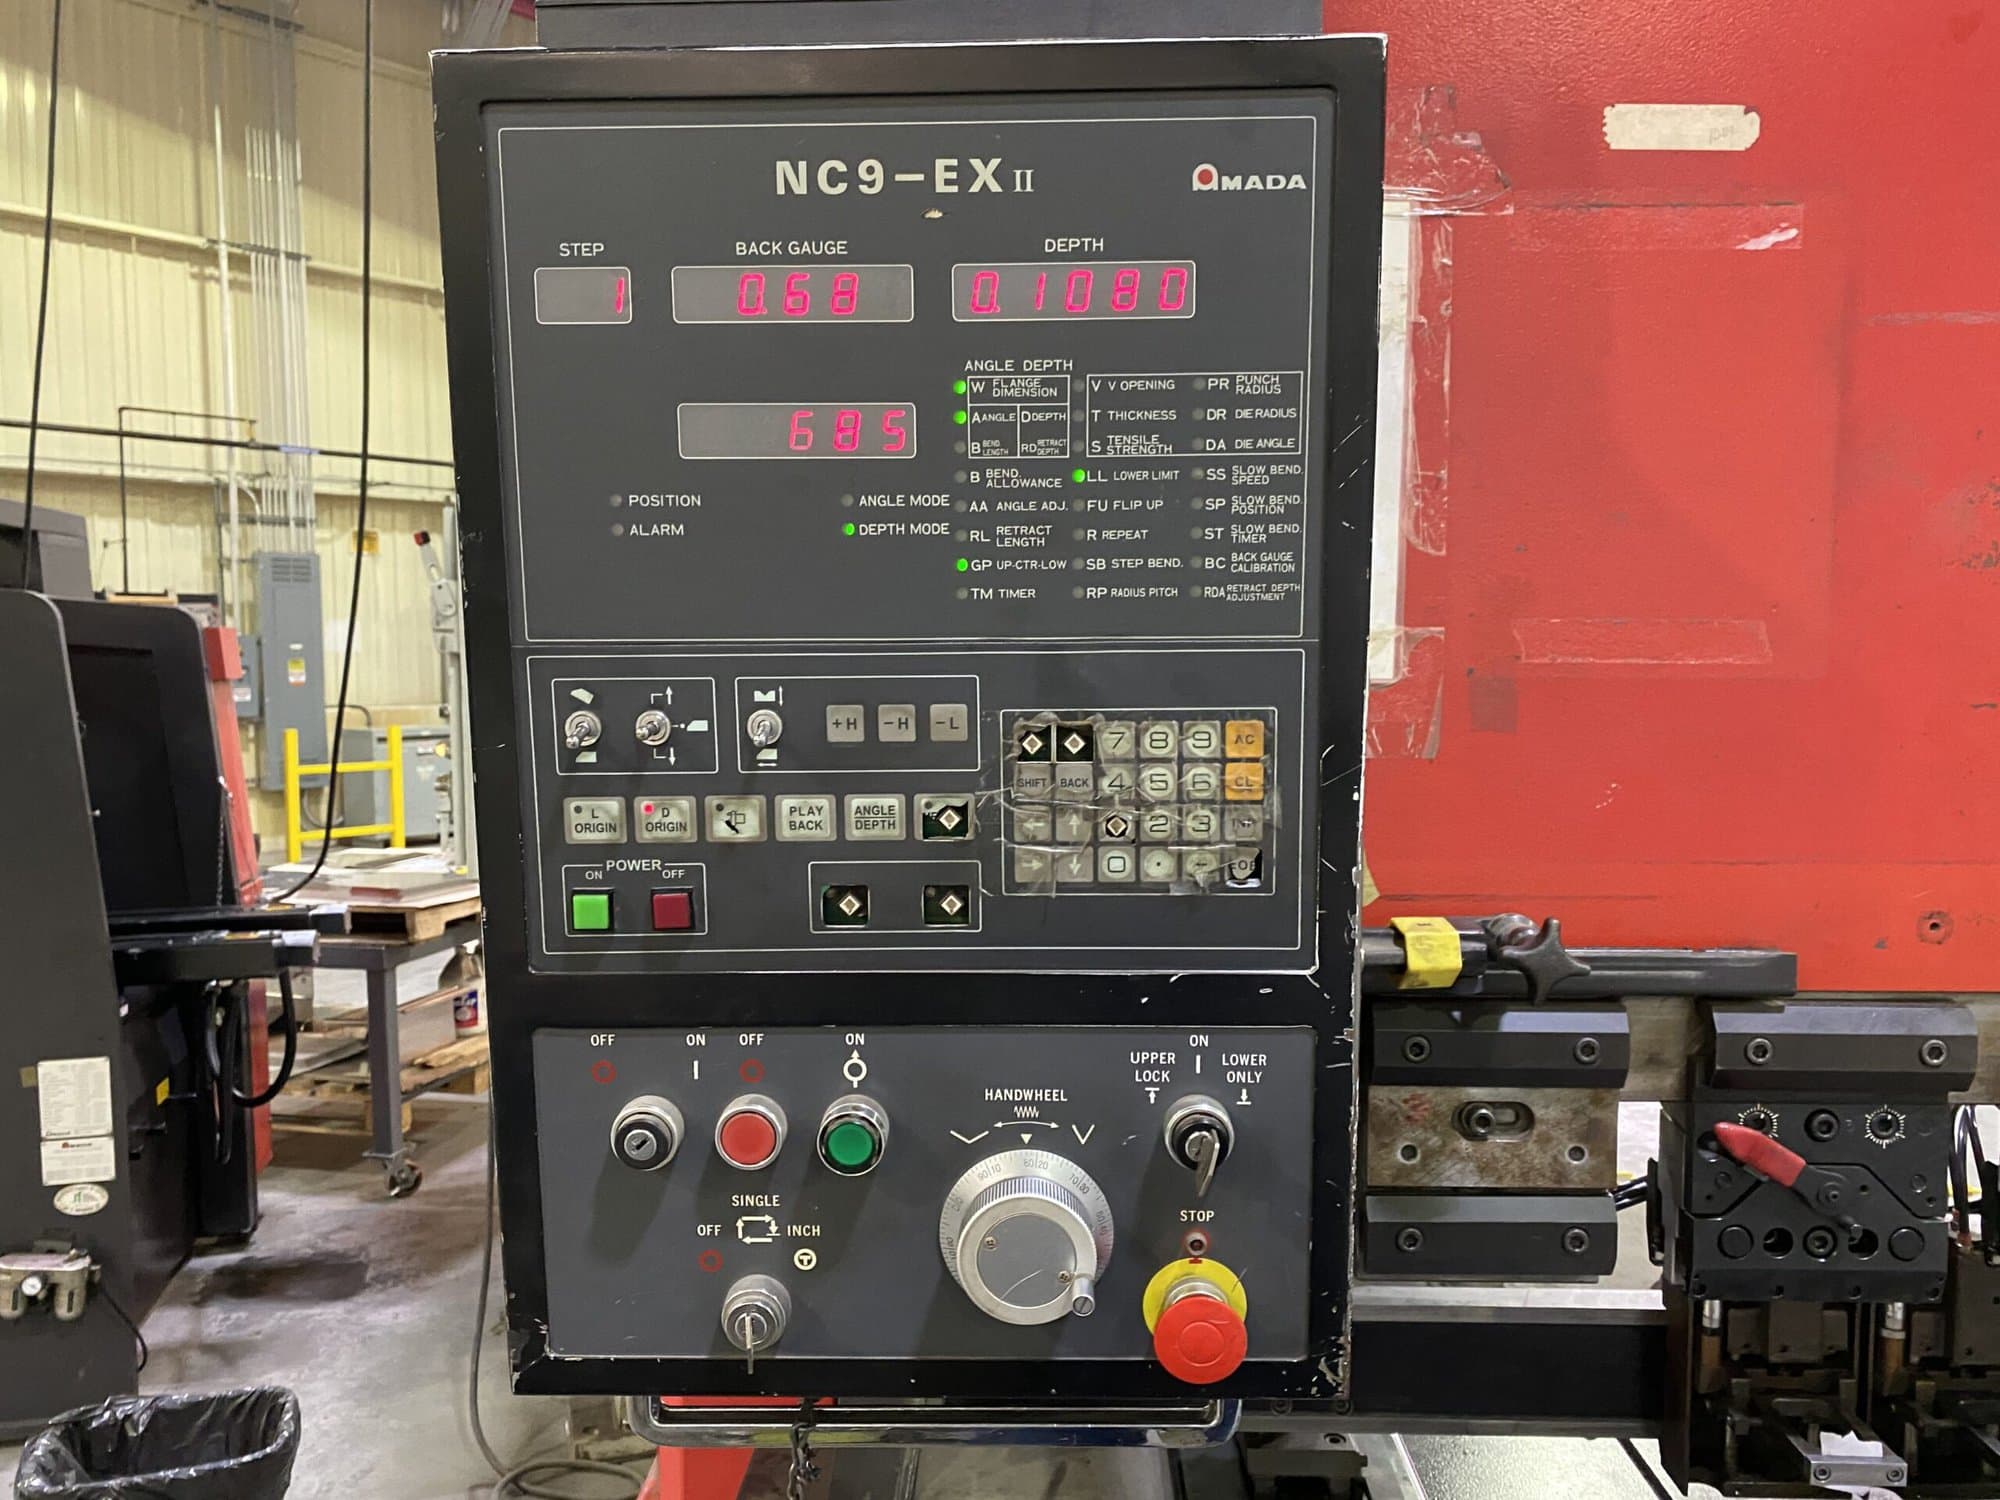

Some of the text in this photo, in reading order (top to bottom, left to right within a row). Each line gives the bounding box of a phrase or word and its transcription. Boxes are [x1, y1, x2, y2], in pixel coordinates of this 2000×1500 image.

[1192, 163, 1307, 192] AMADA
[559, 242, 605, 258] STEP
[735, 240, 849, 256] BACK GAUGE
[1043, 237, 1105, 254] DEPTH
[614, 276, 626, 314] 1
[964, 359, 1074, 372] ANGLE DEPTH
[992, 378, 1042, 388] FLANGE
[1091, 379, 1176, 392] V V OPENING
[1207, 378, 1230, 391] PR
[1235, 374, 1280, 386] PUNCH
[970, 381, 986, 393] W
[992, 387, 1058, 397] DIMENSION
[1235, 384, 1282, 396] RADIUS
[1091, 409, 1177, 422] T THICKNESS
[1206, 408, 1297, 421] DR DIE RADIUS
[982, 439, 1000, 448] BEND
[1037, 438, 1067, 447] RETRACT
[1106, 434, 1160, 446] TENSILE
[1206, 437, 1296, 451] DA DIE ANGLE
[971, 441, 981, 454] B
[982, 448, 1009, 456] LENGTH
[1021, 443, 1038, 453] RD
[1037, 447, 1060, 456] DEPTH
[1091, 441, 1101, 453] S
[1106, 444, 1173, 456] STRENGTH
[985, 469, 1022, 480] BEND.
[1086, 470, 1180, 482] LL LOWER LIMIT
[1206, 468, 1227, 481] SS
[1231, 465, 1267, 475] SLOW
[970, 471, 981, 483] B
[985, 478, 1063, 489] ALLOWANCE
[1231, 474, 1270, 486] SPEED
[628, 494, 702, 508] POSITION
[858, 494, 951, 507] ANGLE MODE
[969, 500, 1069, 513] AA ANGLE ADJ.
[1086, 498, 1165, 512] FU FLIP UP
[1204, 498, 1226, 511] SP
[1231, 495, 1267, 505] SLOW
[1230, 504, 1285, 516] POSITION
[629, 523, 685, 537] ALARM
[858, 522, 951, 536] DEPTH MODE
[995, 524, 1053, 536] RETRACT
[1086, 528, 1149, 541] R REPEAT
[1204, 527, 1225, 540] ST
[1230, 523, 1266, 534] SLOW
[969, 529, 991, 542] RL
[1230, 533, 1268, 544] TIMER
[995, 536, 1046, 549] LENGTH
[1086, 557, 1184, 571] SB STEP BEND.
[1204, 557, 1227, 570] BC
[1231, 552, 1294, 563] BACK GAUGE
[970, 559, 993, 572] GP
[1230, 562, 1296, 574] CALIBRATION
[970, 587, 1037, 600] TM TIMER
[1086, 586, 1179, 599] RP RADIUS PITCH
[1204, 586, 1227, 598] RDA
[1226, 583, 1301, 593] RETRACT DEPTH
[1226, 592, 1287, 602] ADJUSTMENT
[1108, 731, 1126, 750] 7
[1149, 730, 1169, 749] 8
[1191, 730, 1212, 749] 9
[1234, 734, 1256, 746] AC
[1016, 777, 1048, 789] SHIFT
[1060, 777, 1089, 789] BACK
[1107, 773, 1126, 792] 4
[1149, 773, 1169, 792] 5
[1191, 772, 1212, 791] 6
[1234, 775, 1252, 787] CL
[591, 807, 600, 819] L
[661, 806, 671, 818] D
[789, 805, 824, 818] PLAY
[854, 804, 896, 817] ANGLE
[574, 820, 618, 834] ORIGIN
[645, 819, 688, 833] ORIGIN
[789, 818, 824, 831] BACK
[855, 817, 897, 831] DEPTH
[1149, 815, 1169, 834] 2
[1191, 814, 1212, 833] 3
[606, 858, 663, 872] POWER
[1107, 856, 1127, 873] 0
[585, 869, 603, 881] ON
[662, 868, 685, 881] OFF
[590, 1034, 616, 1047] OFF
[686, 1034, 706, 1047] ON
[739, 1033, 765, 1047] OFF
[845, 1033, 866, 1046] ON
[1189, 1035, 1209, 1048] ON
[1130, 1052, 1176, 1065] UPPER
[1221, 1054, 1267, 1067] LOWER
[1134, 1069, 1171, 1083] LOCK
[1226, 1071, 1263, 1084] ONLY
[984, 1088, 1068, 1103] HANDWHEEL
[731, 1194, 780, 1207] SINGLE
[1180, 1209, 1215, 1223] STOP
[697, 1224, 722, 1237] OFF
[787, 1224, 821, 1237] INCH
